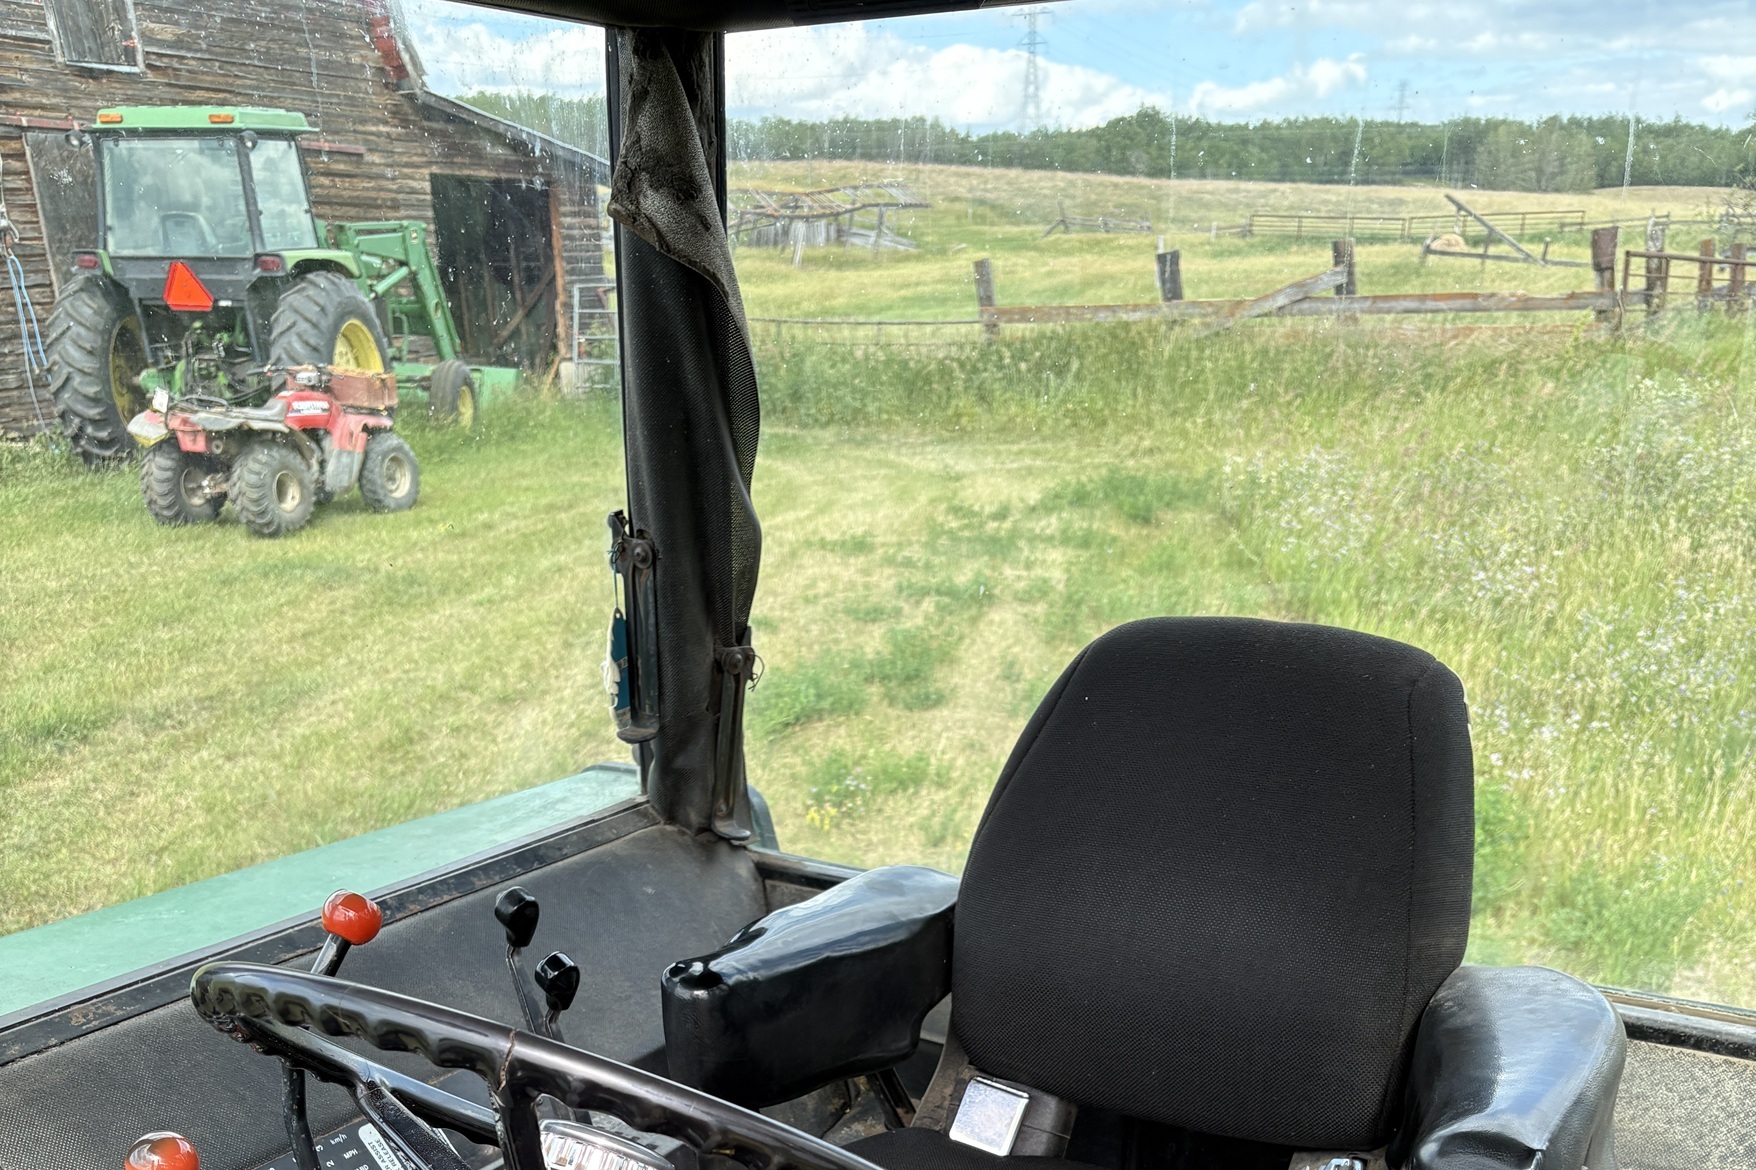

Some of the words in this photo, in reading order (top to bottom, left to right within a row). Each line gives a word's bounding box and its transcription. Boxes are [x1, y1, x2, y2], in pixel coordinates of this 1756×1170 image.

[330, 1134, 348, 1146] km/h
[343, 1148, 358, 1159] MPH
[368, 1142, 387, 1164] ASSIST
[376, 1139, 398, 1166] RELEASE
[326, 1160, 335, 1168] 2
